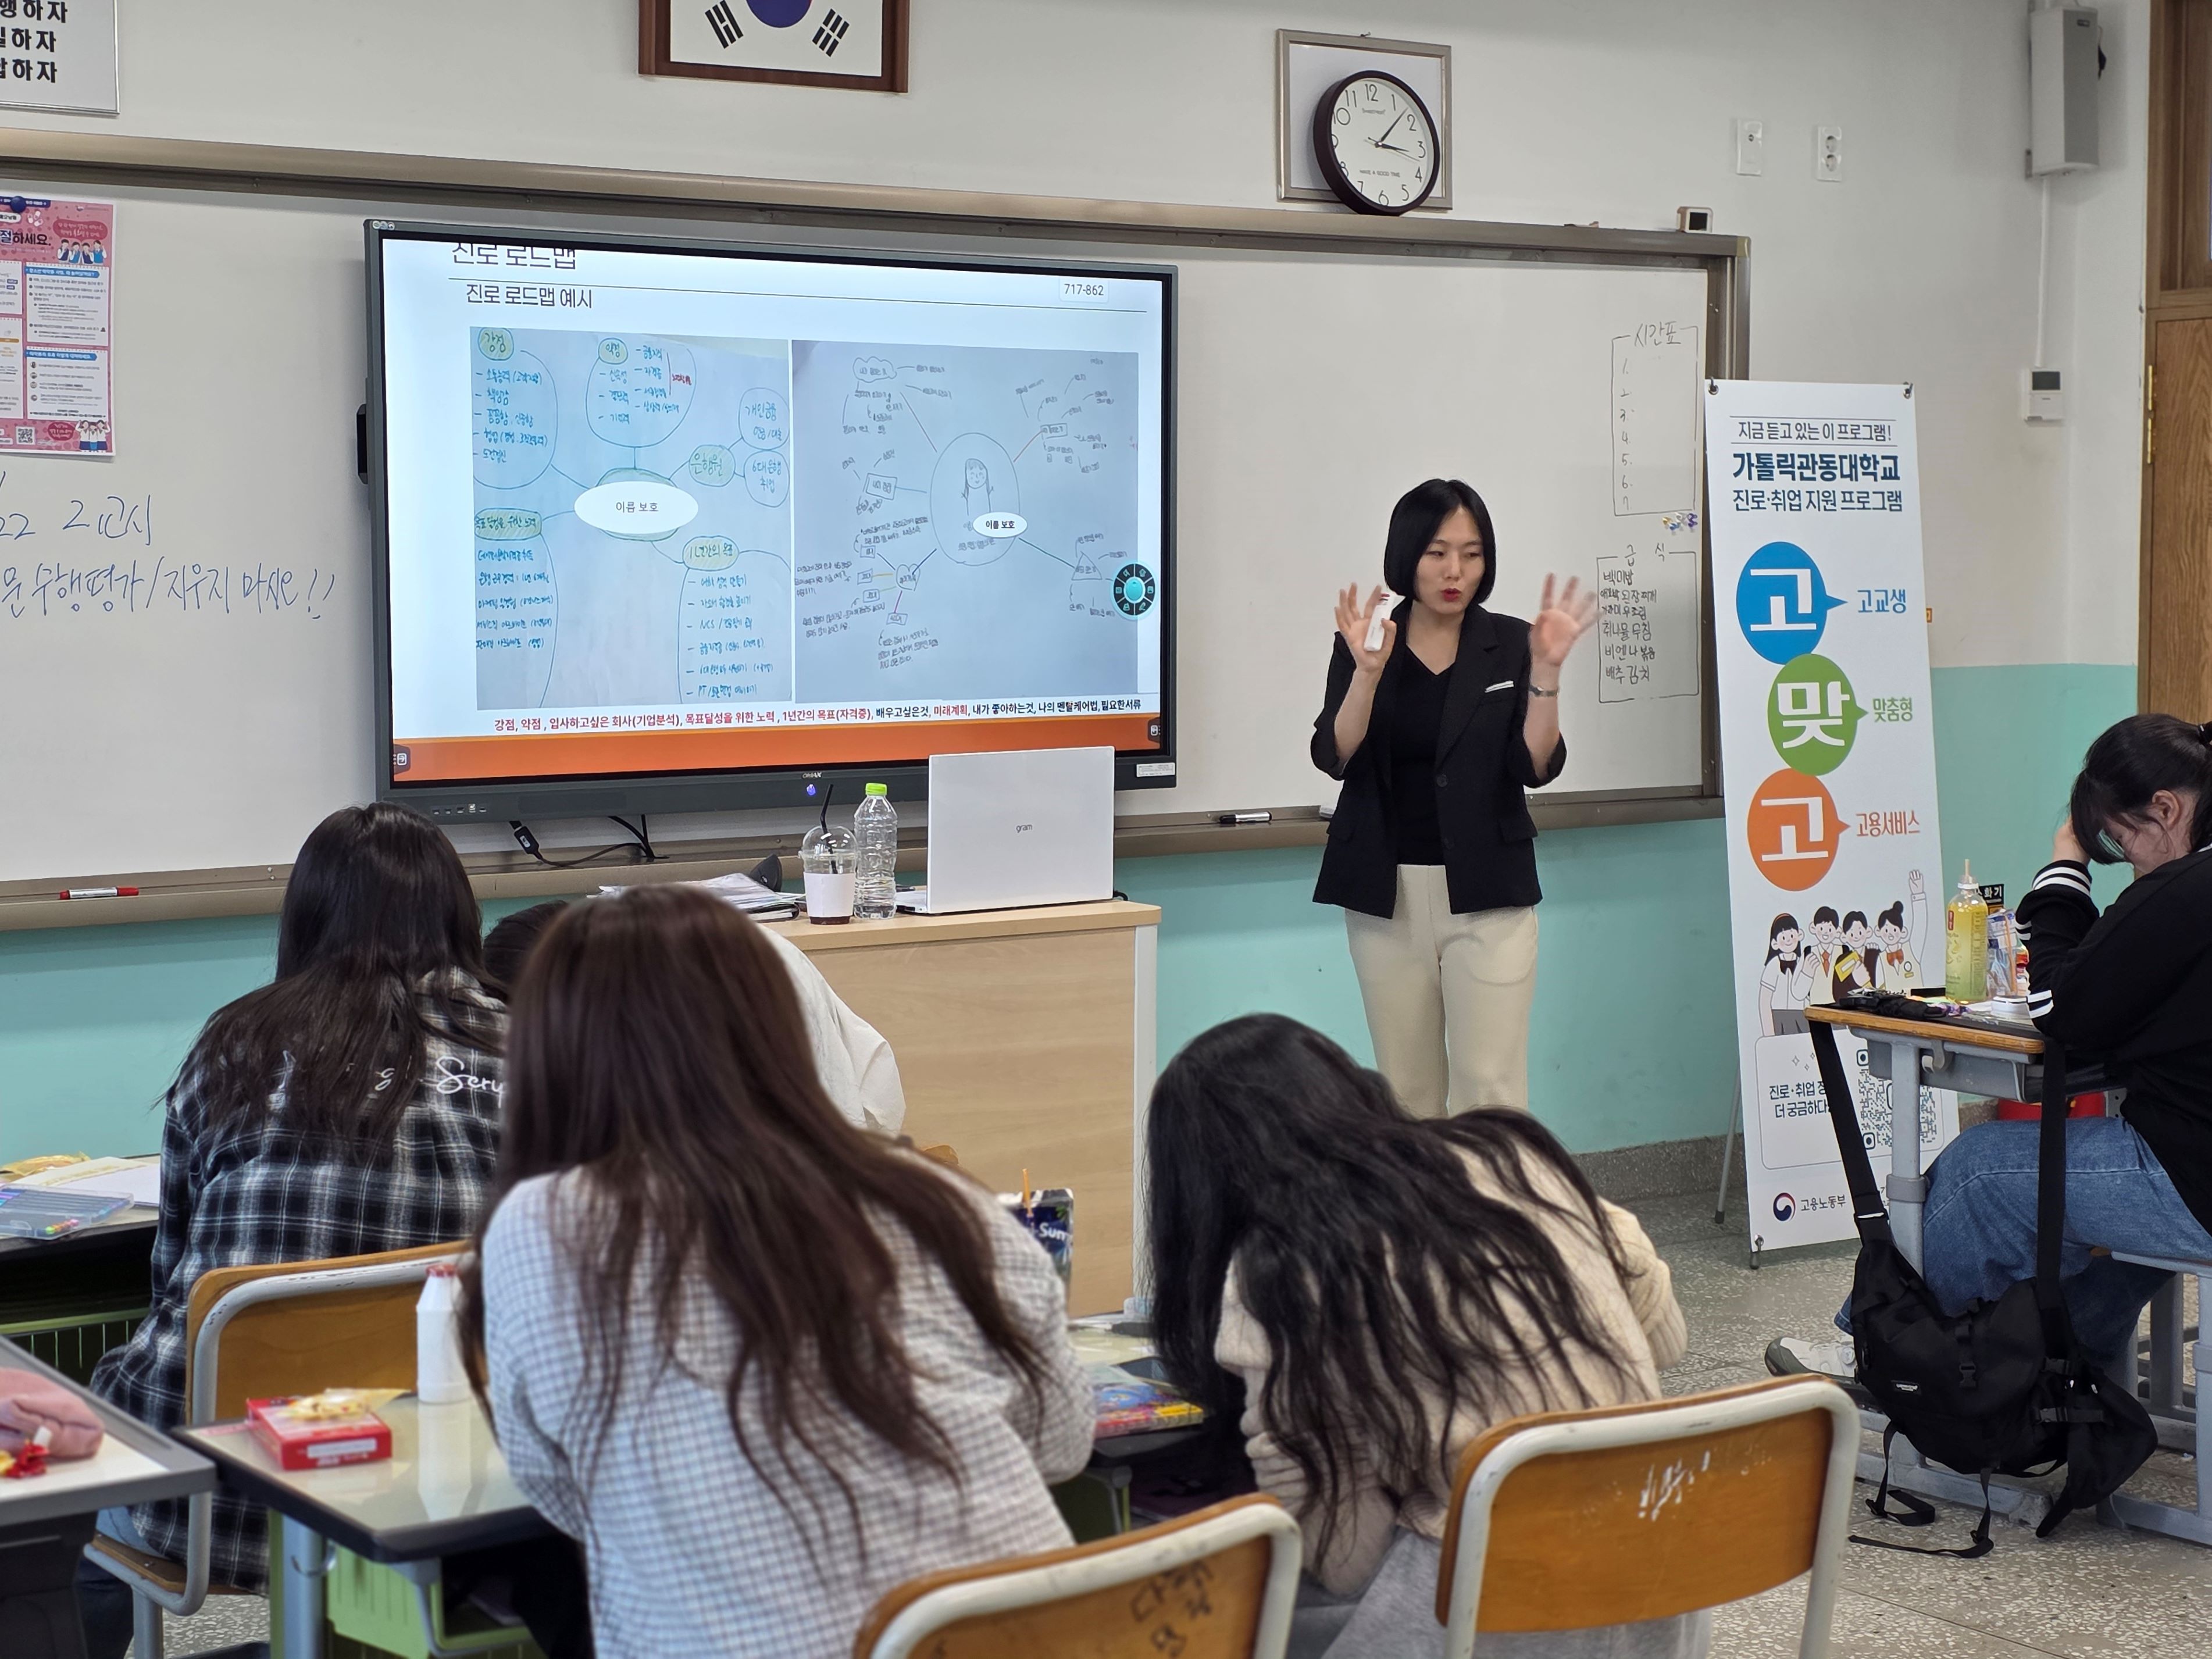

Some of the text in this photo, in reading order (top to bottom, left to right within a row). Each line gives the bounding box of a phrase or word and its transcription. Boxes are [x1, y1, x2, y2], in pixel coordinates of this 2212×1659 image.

[1345, 90, 1357, 108] 11
[1365, 84, 1378, 102] 12
[1392, 94, 1396, 111] 1
[1407, 114, 1417, 131] 2
[1418, 141, 1426, 158] 3
[1415, 166, 1422, 183] 4
[1378, 190, 1389, 206] 6
[1401, 184, 1410, 201] 5
[466, 284, 592, 308] 진로 로드맵 예시
[1064, 283, 1104, 296] 717-862
[1635, 321, 1681, 347] 시간표
[1739, 421, 1892, 441] 지금 듣고 있는 이 프로그램!
[1733, 452, 1900, 482] 가톨릭관동대학교
[616, 501, 659, 513] 이름 보호
[1733, 489, 1903, 512] 진로·취업 지원 프로그램
[1603, 569, 1634, 586] 백미밥
[1750, 569, 1817, 631] 고
[1857, 588, 1906, 613] 고교생
[494, 718, 518, 732] 강점,
[550, 716, 609, 730] 입사하고싶은
[612, 714, 682, 727] 회사(기업분석),
[686, 712, 733, 725] 목표달성을
[735, 711, 754, 723] 위한
[756, 711, 775, 722] 노력
[783, 709, 815, 722] 1년간의
[817, 708, 873, 721] 목표(자격증),
[876, 706, 931, 719] 배우고싶은것,
[934, 704, 971, 717] 미래계획,
[973, 704, 990, 715] 내가
[991, 702, 1036, 715] 좋아하는것,
[1039, 702, 1055, 713] 나의
[1777, 681, 1850, 748] 맞
[1873, 697, 1913, 723] 맞춤형
[1016, 824, 1033, 833] gram
[1761, 797, 1829, 862] 고
[1856, 811, 1921, 837] 고용서비스
[1769, 1081, 1815, 1100] 진로·취업
[1775, 1098, 1831, 1118] 더 궁금하다
[1801, 1194, 1846, 1211] 고용노동부
